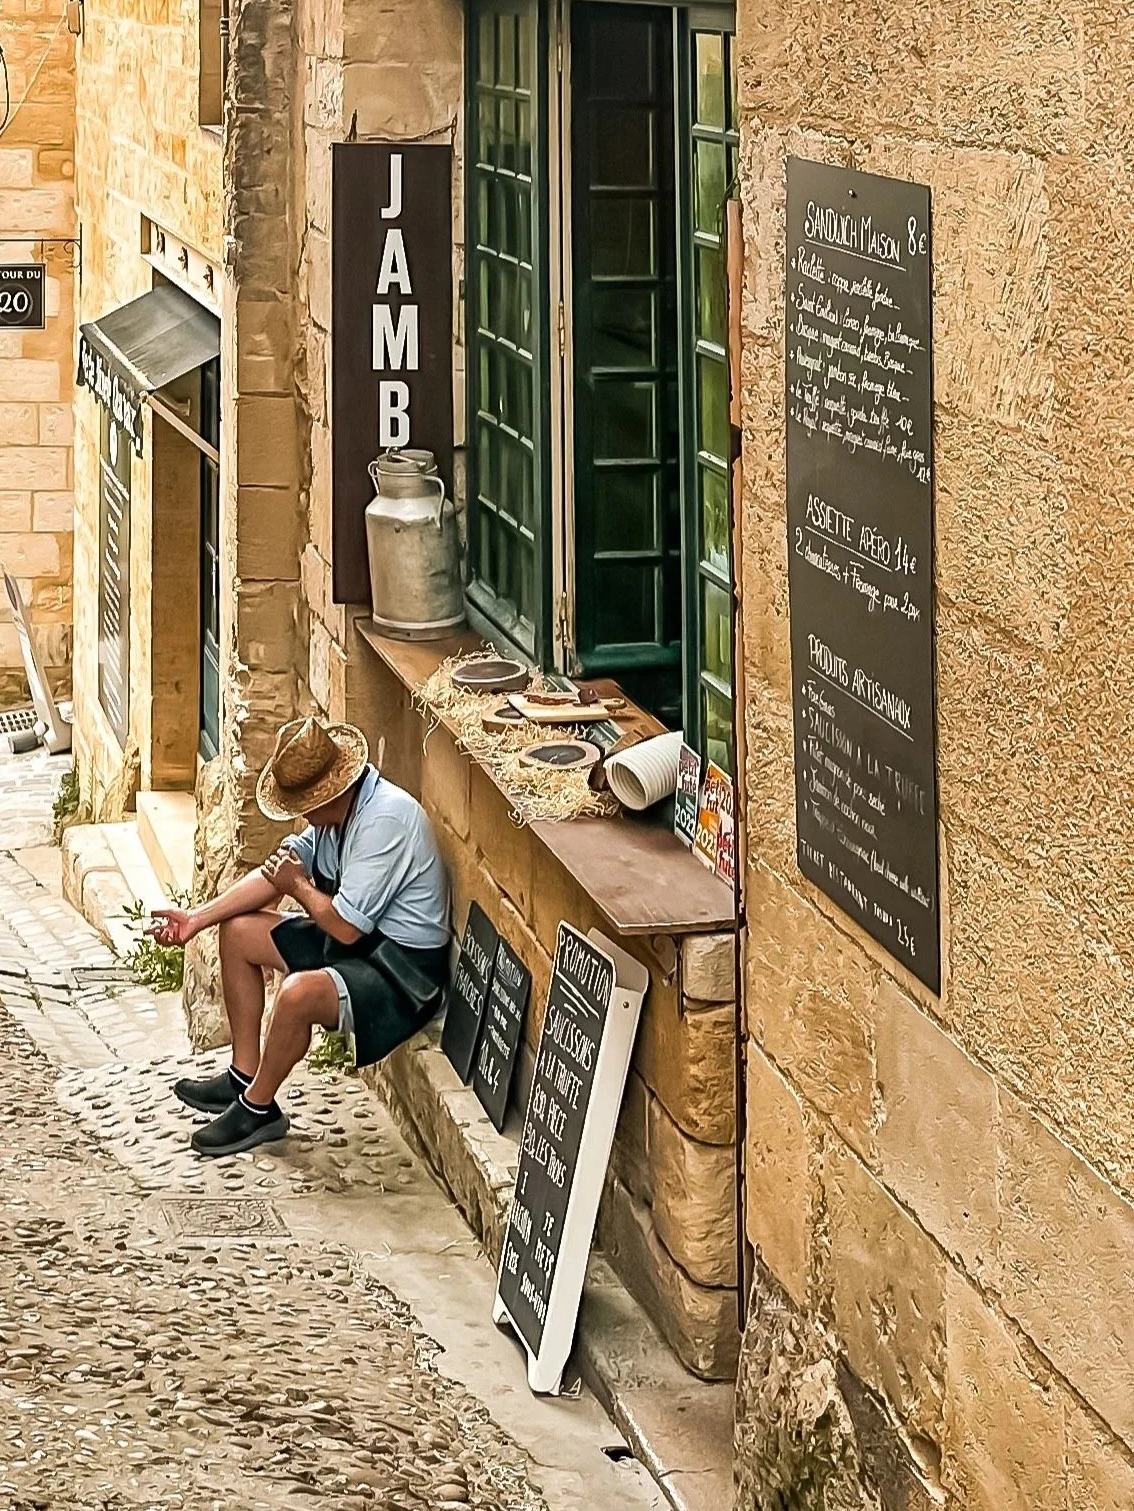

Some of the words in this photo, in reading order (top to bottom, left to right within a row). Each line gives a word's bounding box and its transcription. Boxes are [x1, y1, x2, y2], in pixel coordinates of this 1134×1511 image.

[804, 201, 857, 247] SANDWICH
[860, 216, 900, 262] MAISON
[26, 271, 41, 279] DU
[805, 494, 854, 541] ASSIETTE
[807, 633, 849, 686] PRODUITS
[556, 929, 614, 1007] PROMOTION
[545, 1005, 595, 1071] SAUCISSONS
[544, 1051, 557, 1081] LA
[553, 1059, 583, 1110] TRUFFE
[534, 1135, 550, 1166] LES
